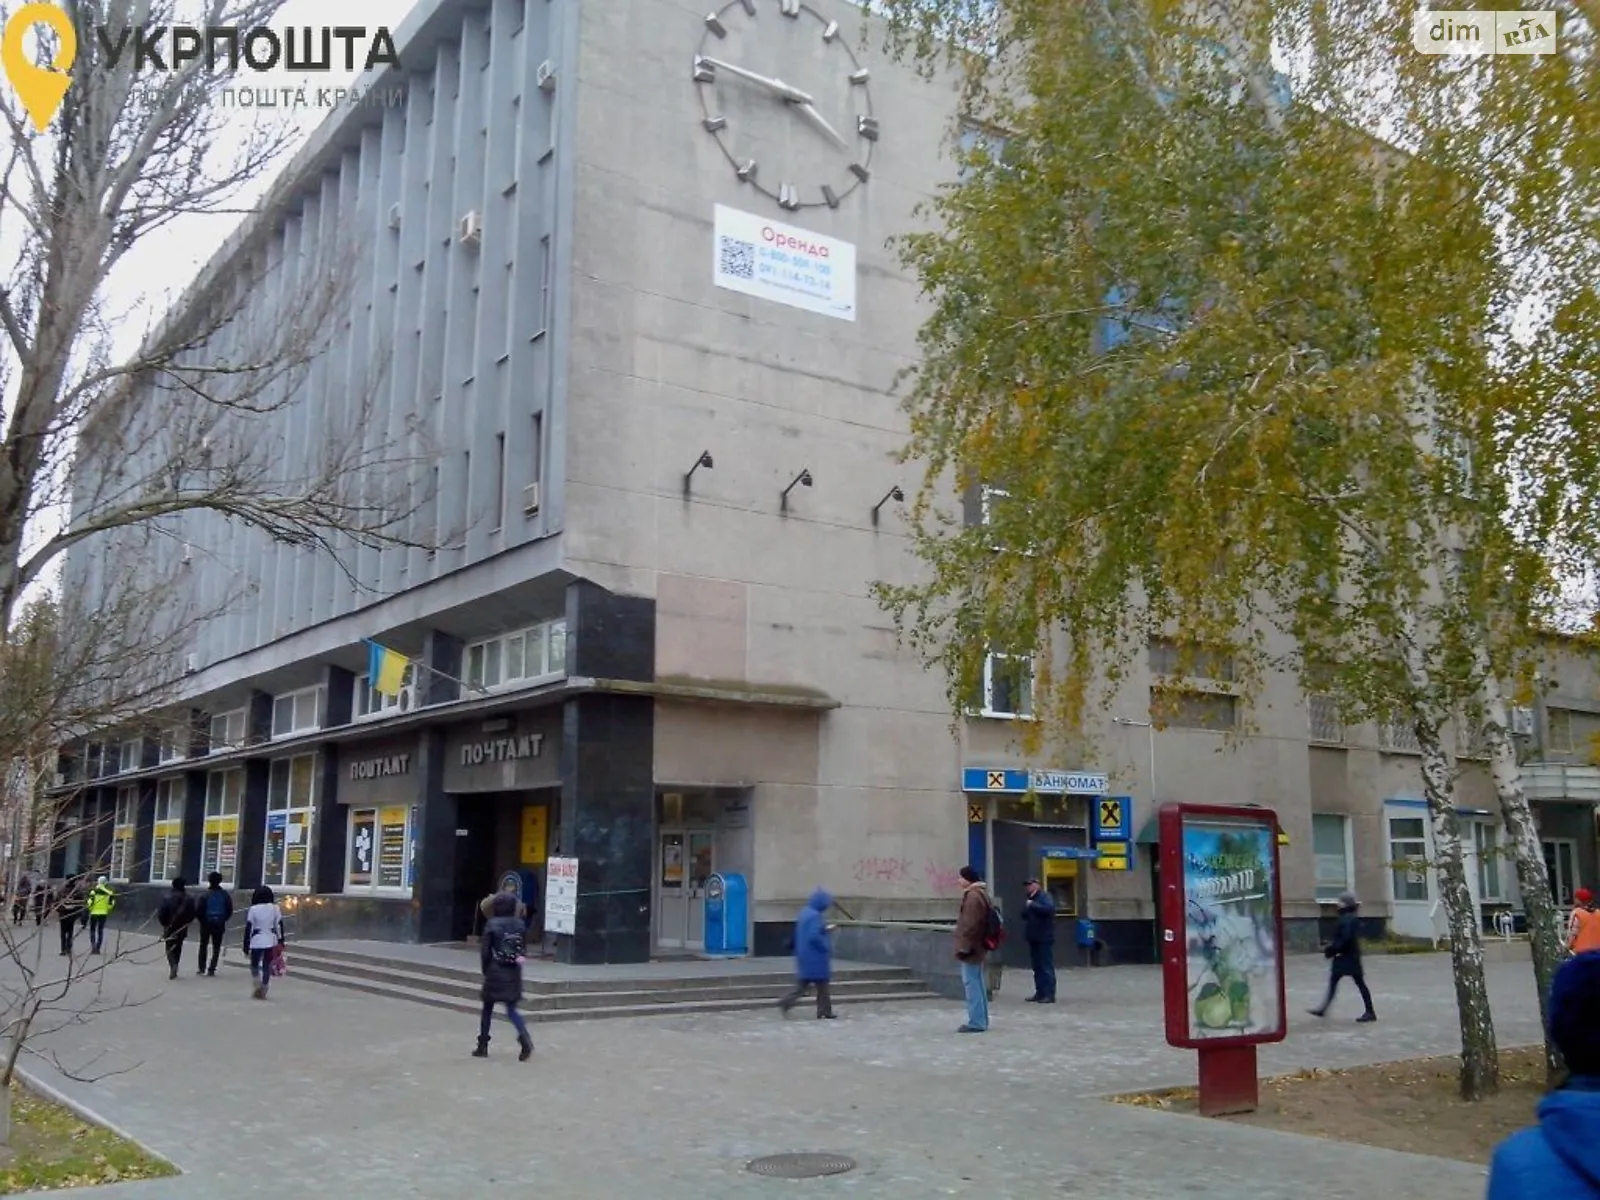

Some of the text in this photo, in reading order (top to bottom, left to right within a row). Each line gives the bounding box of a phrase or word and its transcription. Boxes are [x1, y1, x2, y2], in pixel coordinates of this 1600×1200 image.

[761, 226, 829, 257] Оренда
[462, 734, 543, 765] ПОЧТАМТ
[351, 754, 409, 779] ПОШТАМТ
[1035, 774, 1104, 789] БАНКОМАТ
